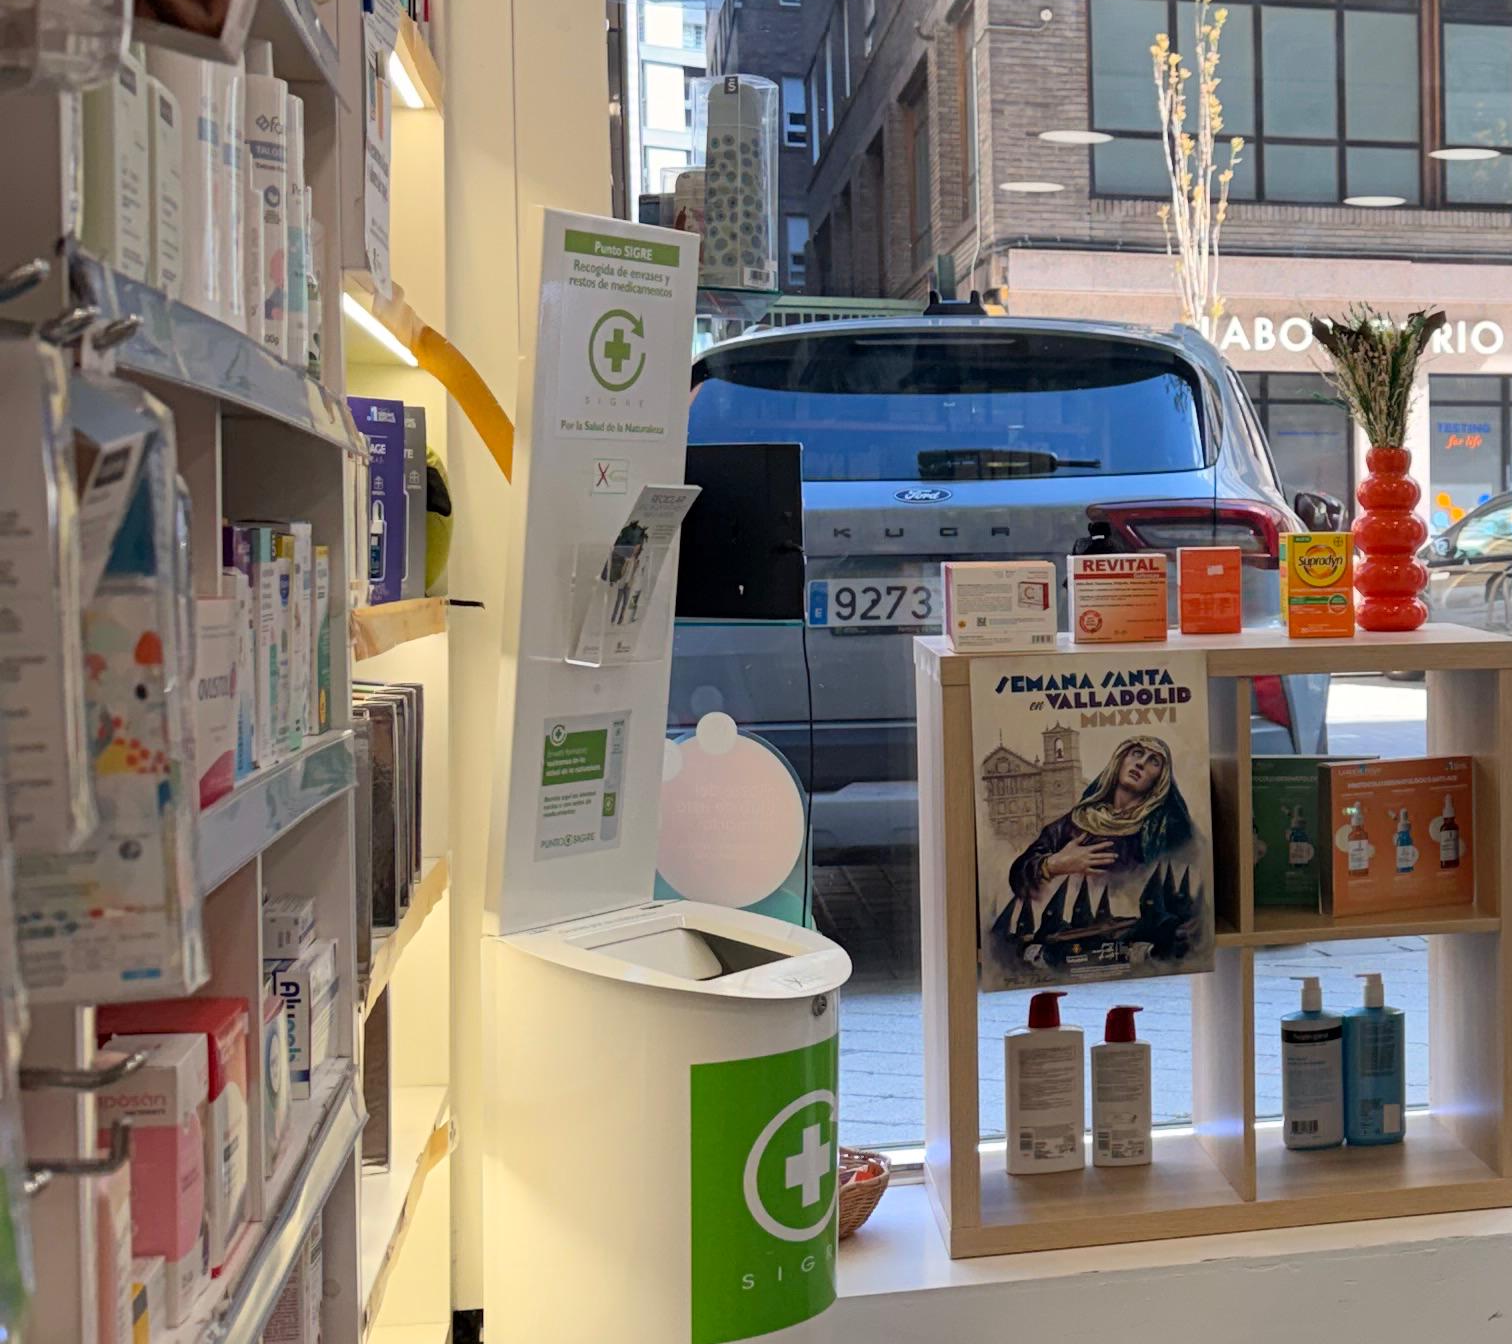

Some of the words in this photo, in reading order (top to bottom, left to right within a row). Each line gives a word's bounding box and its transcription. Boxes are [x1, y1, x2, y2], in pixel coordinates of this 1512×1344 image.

[594, 241, 622, 257] Punto
[624, 245, 653, 261] SIGRE
[573, 259, 615, 277] Recogida
[617, 265, 628, 277] de
[630, 270, 663, 283] envases
[664, 275, 670, 286] y
[569, 277, 596, 289] restos
[598, 278, 609, 290] de
[610, 282, 673, 298] medicamentos
[560, 419, 575, 430] Por
[576, 420, 583, 431] la
[584, 420, 605, 432] Salud
[606, 422, 616, 433] de
[616, 423, 624, 433] la
[625, 423, 665, 435] Naturaleza
[903, 487, 942, 501] Ford
[833, 527, 1010, 539] KUGA
[1082, 558, 1160, 572] REVITAL
[1298, 554, 1344, 569] Supradyn
[814, 606, 823, 618] E
[834, 585, 934, 622] 9273
[994, 672, 1095, 695] SEMANA
[1100, 668, 1175, 690] SANTA
[1029, 700, 1045, 712] en
[1044, 685, 1193, 711] VALLADOLID
[1080, 706, 1177, 729] MMXXVI
